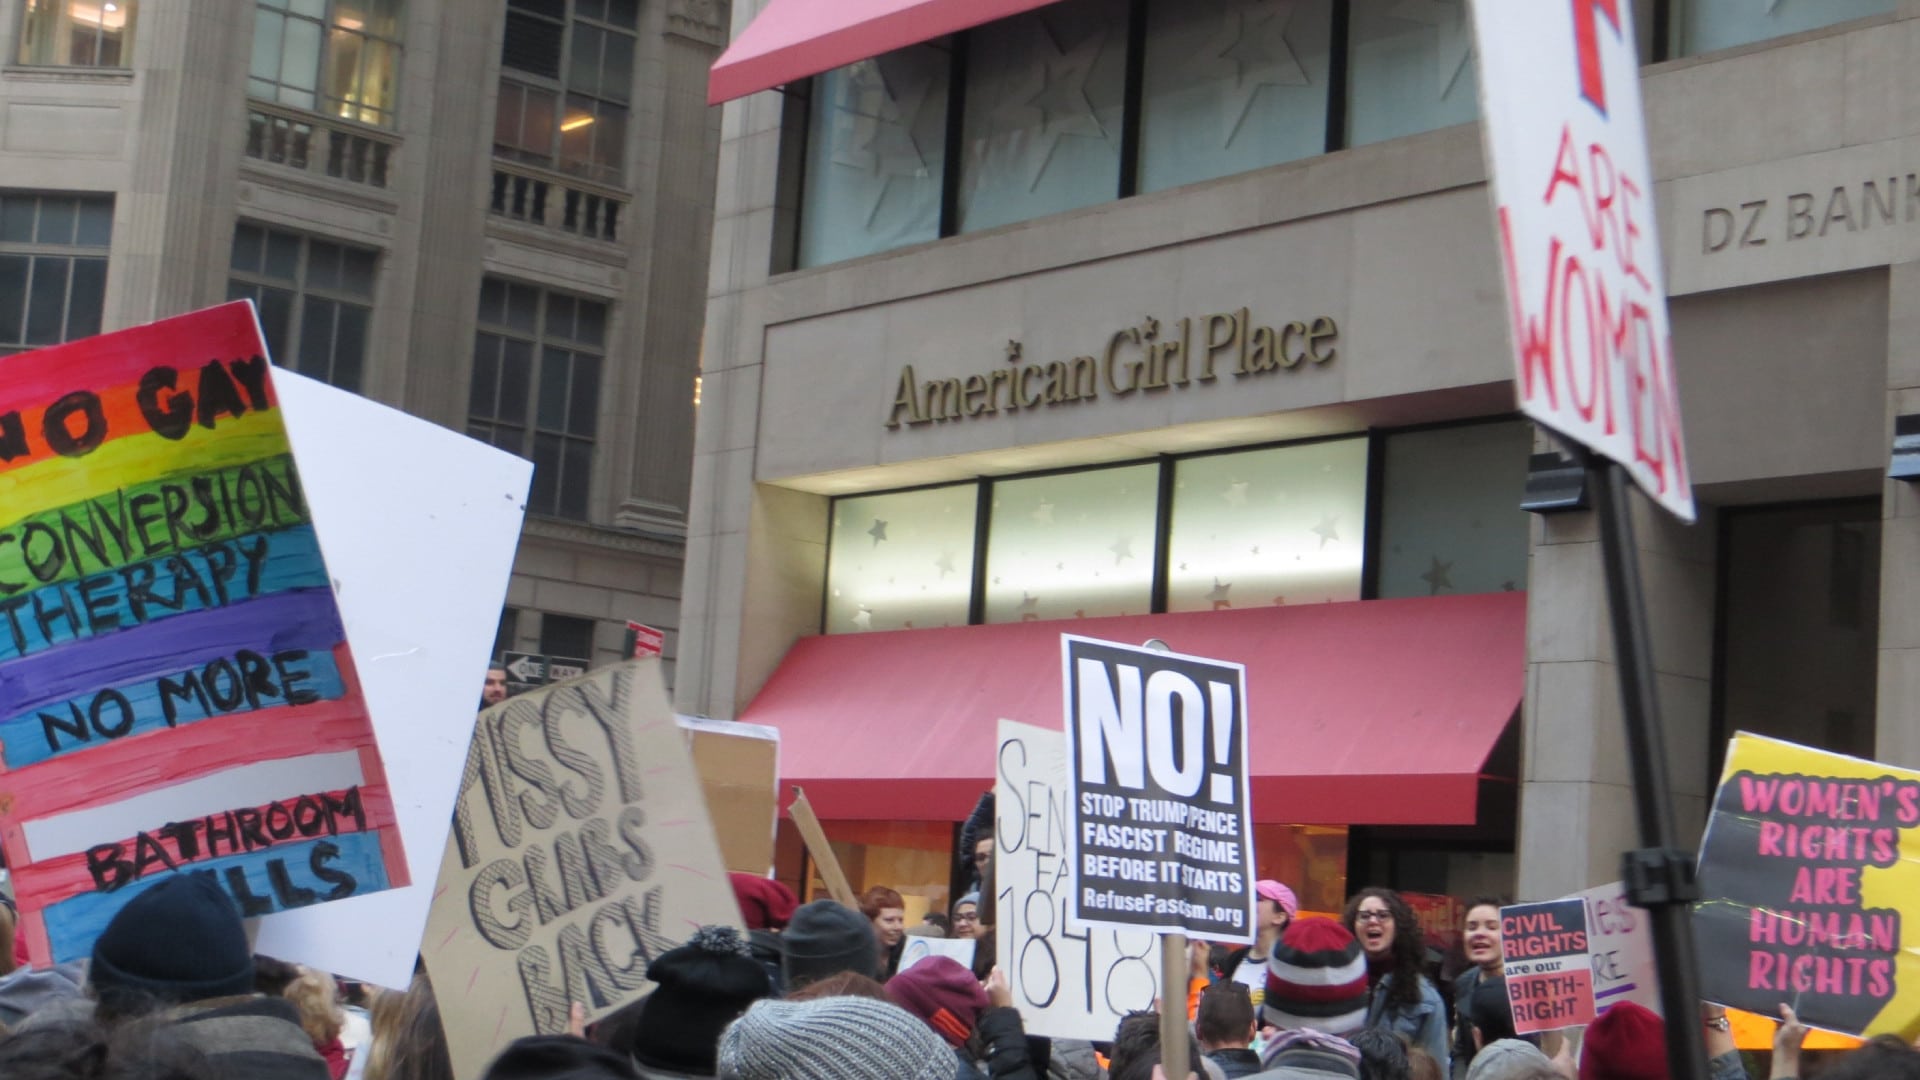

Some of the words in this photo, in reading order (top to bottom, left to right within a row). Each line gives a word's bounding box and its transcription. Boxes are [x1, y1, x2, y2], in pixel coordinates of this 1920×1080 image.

[1543, 122, 1652, 292] ARE
[1702, 200, 1768, 255] DZ
[1786, 173, 1920, 243] BANK
[886, 339, 1098, 428] American
[1104, 316, 1192, 396] Girl
[1197, 306, 1338, 383] Place
[1498, 206, 1690, 500] WOMEN
[136, 354, 269, 440] GAY
[0, 457, 303, 594] CONVERSION
[0, 536, 268, 656] THERAPY
[518, 662, 545, 677] ONE
[38, 688, 135, 751] NO
[158, 649, 320, 728] MORE
[1077, 657, 1234, 804] NO!
[1081, 792, 1125, 818] STOP
[1128, 798, 1238, 836] TRUMP/PENCE
[1739, 776, 1919, 823] WOMEN'S
[86, 785, 366, 892] BATHROOM
[1082, 822, 1167, 852] FASCIST
[1173, 830, 1240, 865] REGIME
[1758, 820, 1893, 864] RIGHTS
[469, 807, 655, 951] GRABS
[1083, 854, 1157, 883] BEFORE
[1160, 860, 1181, 884] IT
[1182, 864, 1242, 894] STARTS
[1789, 867, 1857, 905] ARE
[1502, 912, 1563, 936] CIVIL
[1504, 930, 1586, 958] RIGHTS
[1750, 908, 1894, 951] HUMAN
[999, 886, 1157, 1017] 1848
[1505, 967, 1531, 977] are
[1534, 960, 1562, 973] our
[1748, 950, 1889, 997] RIGHTS
[1509, 975, 1585, 1001] BIRTH-
[1513, 997, 1578, 1023] RIGHT
